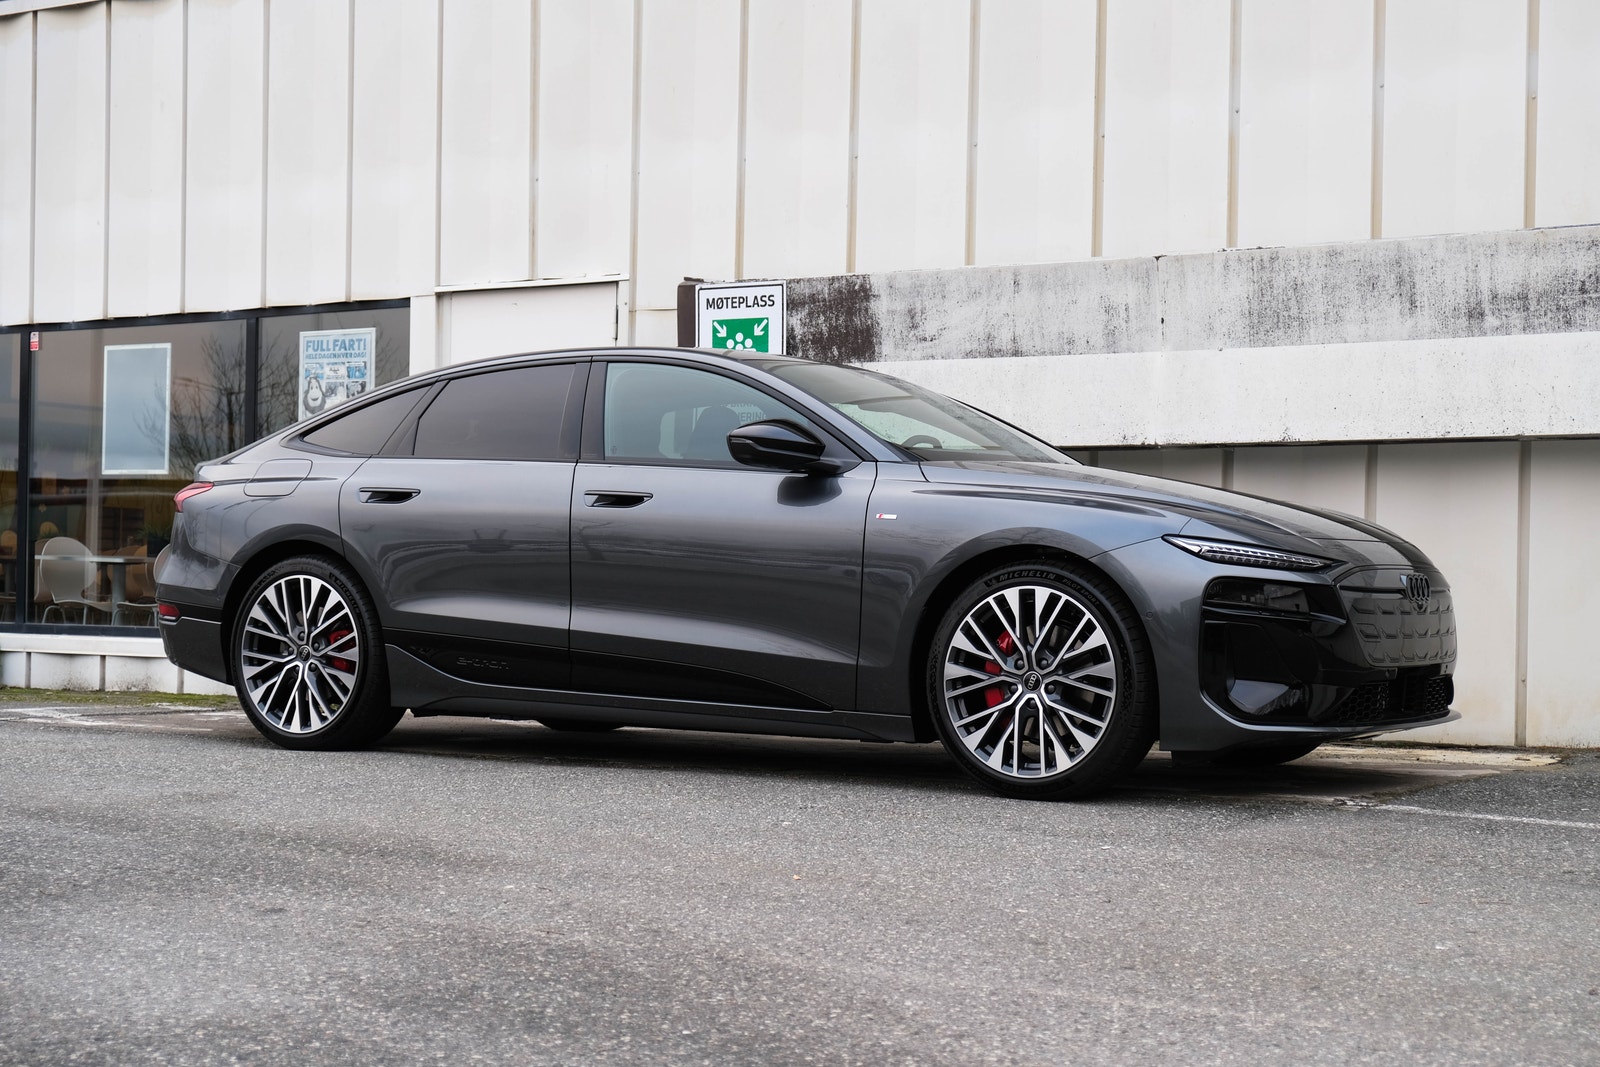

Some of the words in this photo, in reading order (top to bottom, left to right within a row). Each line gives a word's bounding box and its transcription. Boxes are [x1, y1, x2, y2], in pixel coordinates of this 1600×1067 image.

[706, 295, 775, 310] MØTEPLASS
[305, 339, 330, 352] FULL
[332, 338, 367, 351] FART!
[1000, 570, 1057, 581] MICHELIN
[1062, 578, 1081, 590] PILOT
